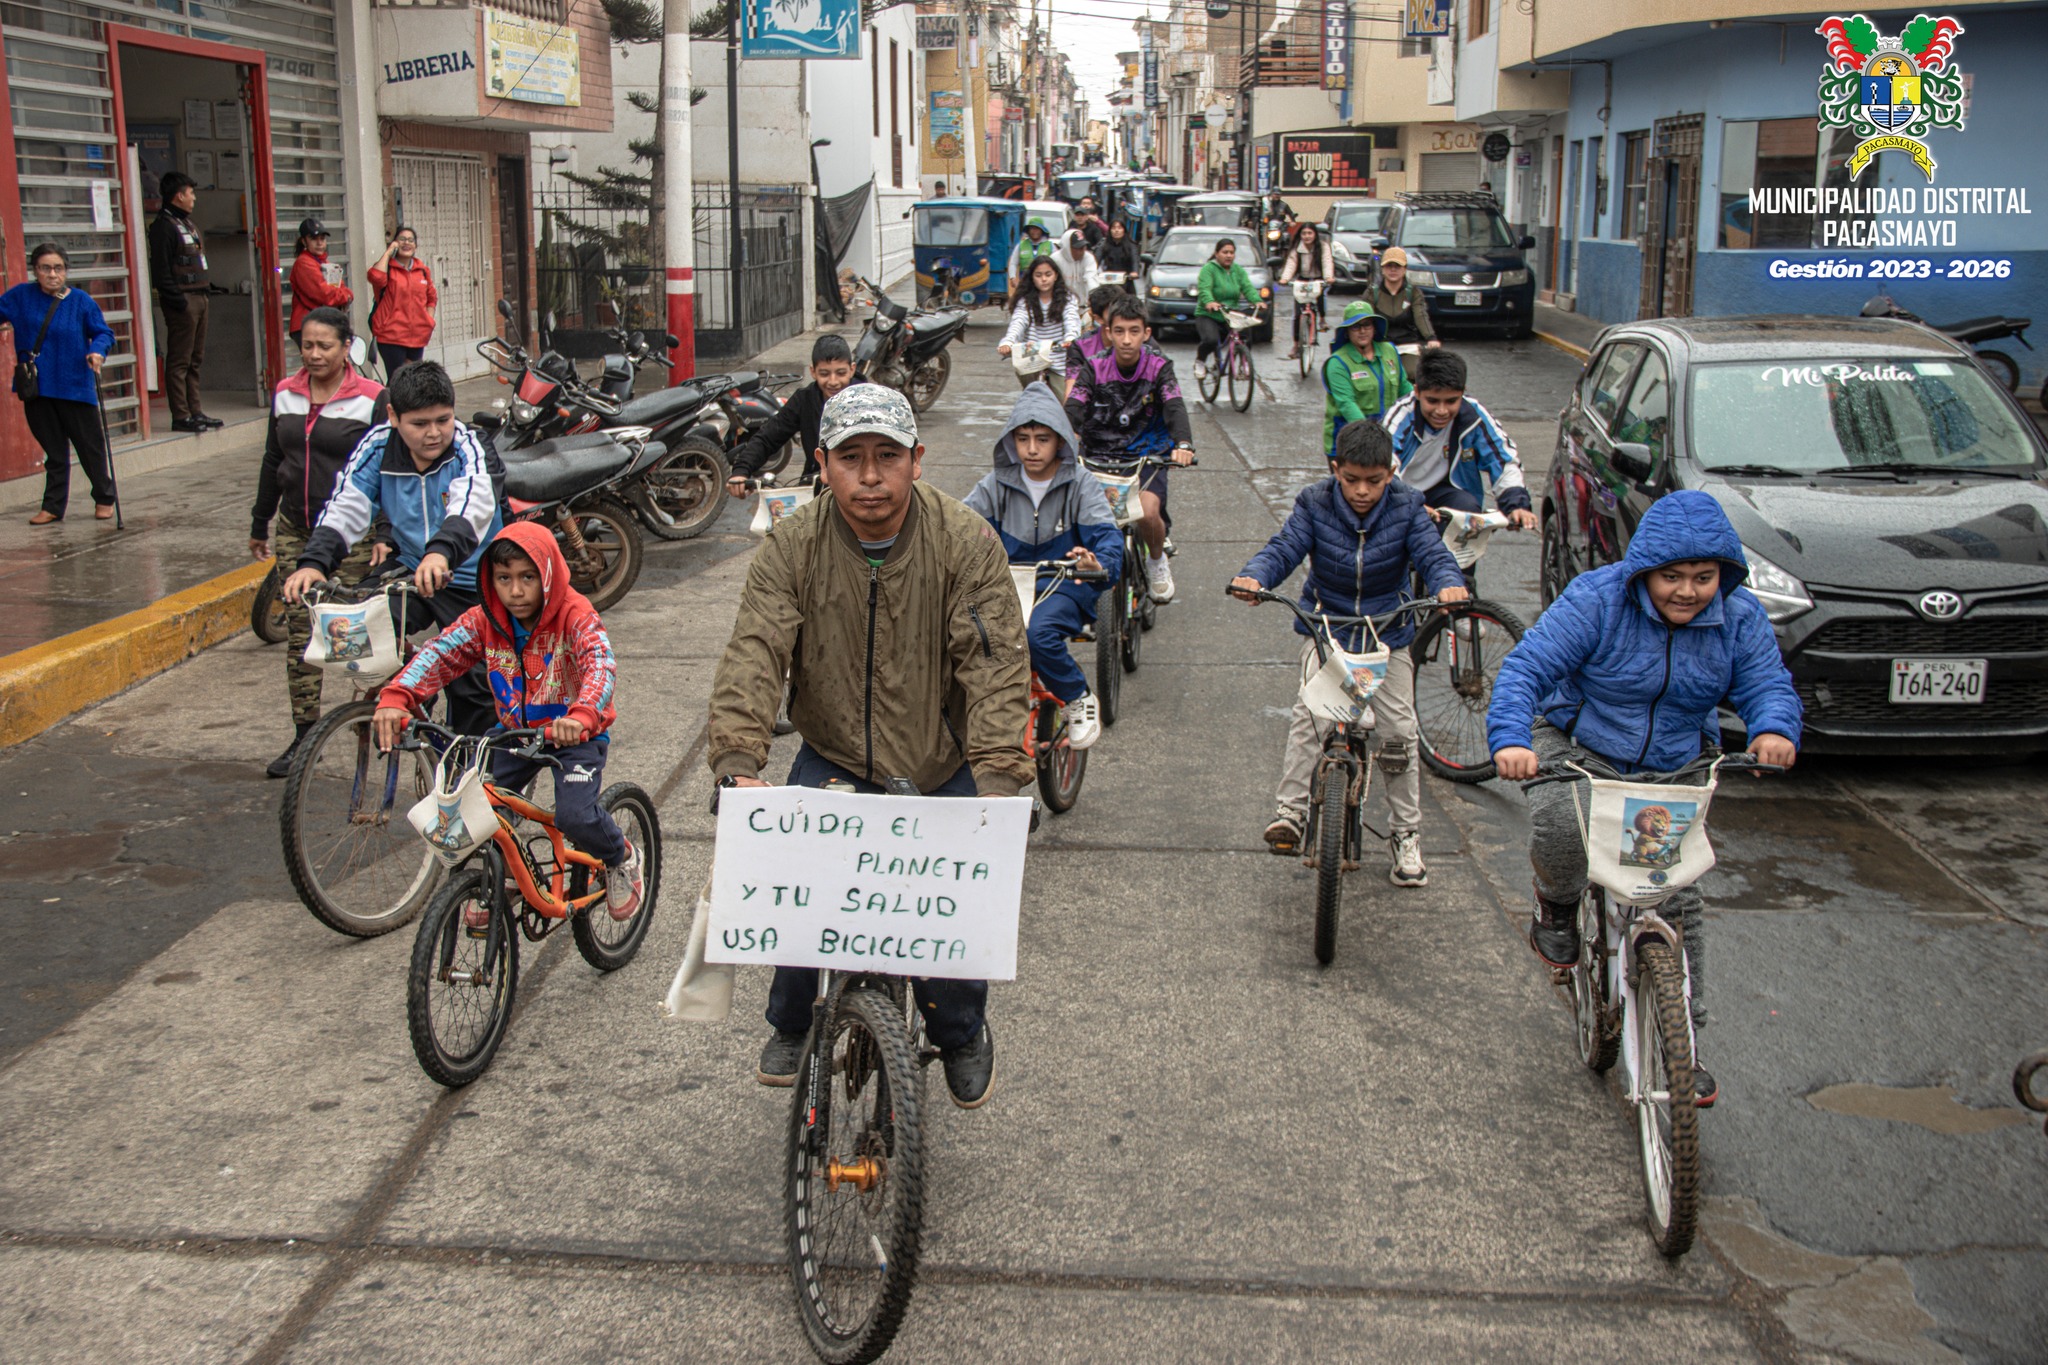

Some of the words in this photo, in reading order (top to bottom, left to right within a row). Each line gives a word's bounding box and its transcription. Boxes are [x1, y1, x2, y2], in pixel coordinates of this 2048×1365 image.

[1326, 2, 1346, 74] STUDIO
[384, 50, 475, 84] LIBRERIA
[1326, 75, 1346, 89] 92
[1288, 141, 1320, 152] BAZAR
[1294, 153, 1333, 170] STUDIO
[1303, 170, 1329, 187] 92
[1761, 365, 1826, 387] Mi
[1820, 363, 1916, 387] Palita
[1923, 663, 1956, 672] PERU
[1897, 672, 1980, 696] T6A-240
[749, 807, 864, 838] CUIDA
[891, 817, 924, 839] EL
[856, 852, 989, 880] PLANETA
[742, 884, 757, 900] Y
[772, 885, 810, 907] TU
[840, 888, 957, 917] SALUD
[722, 927, 779, 951] USA
[817, 928, 967, 961] BICICLETA
